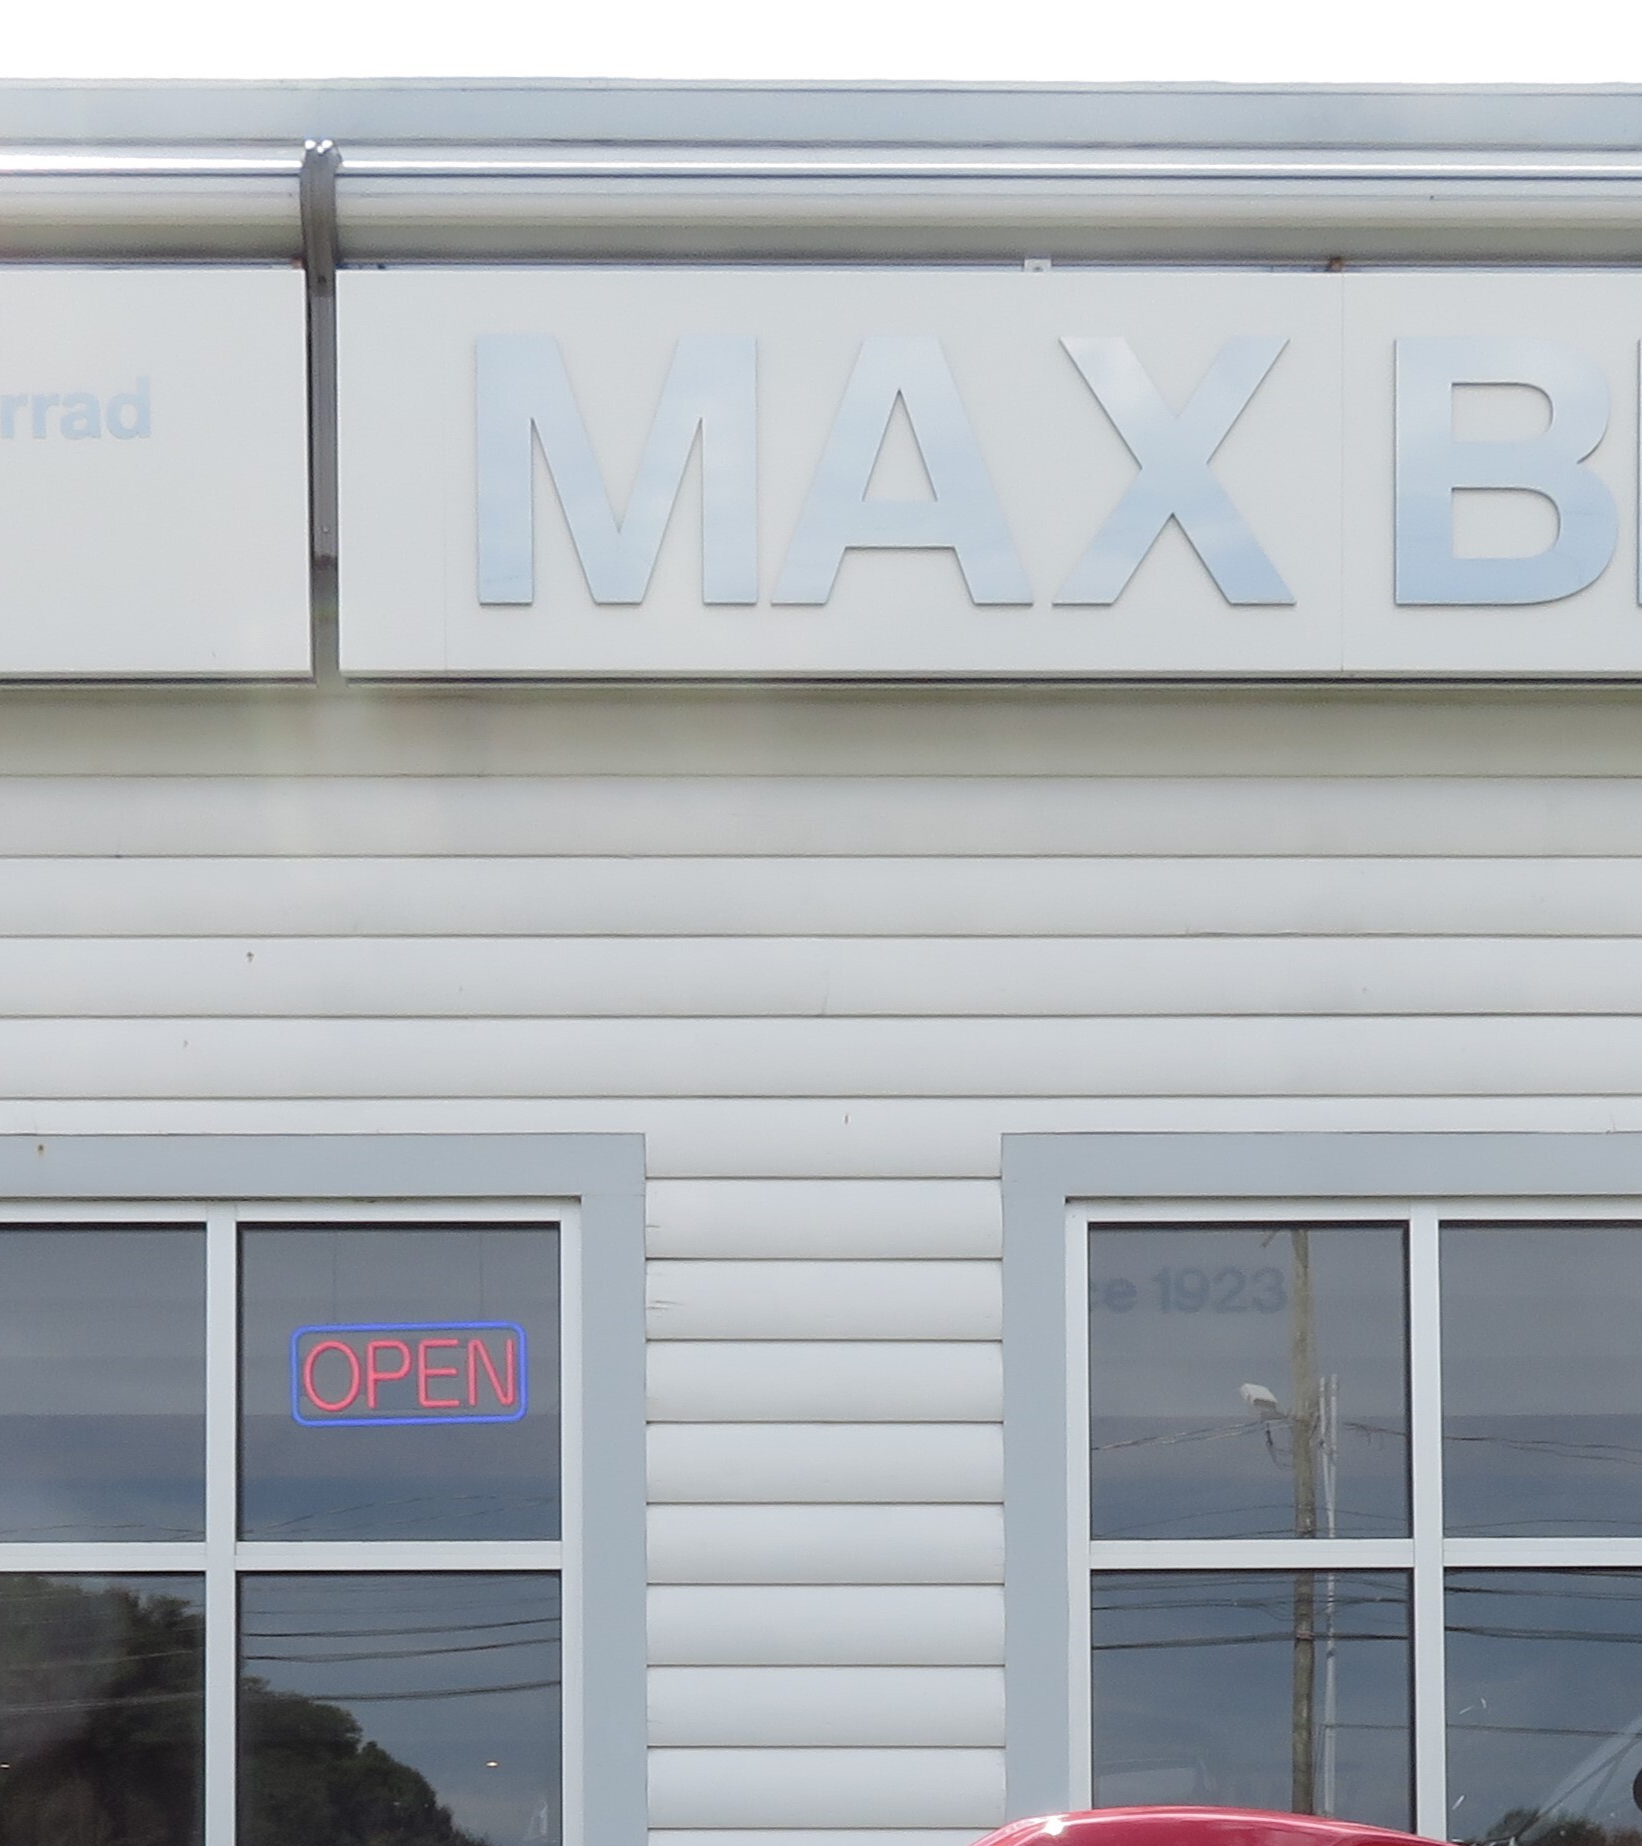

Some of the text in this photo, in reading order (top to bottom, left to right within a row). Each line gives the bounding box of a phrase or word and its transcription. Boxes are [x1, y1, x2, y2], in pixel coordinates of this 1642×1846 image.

[475, 335, 1297, 606] MAX
[1152, 1265, 1288, 1314] 1923
[302, 1338, 515, 1412] OPEN
